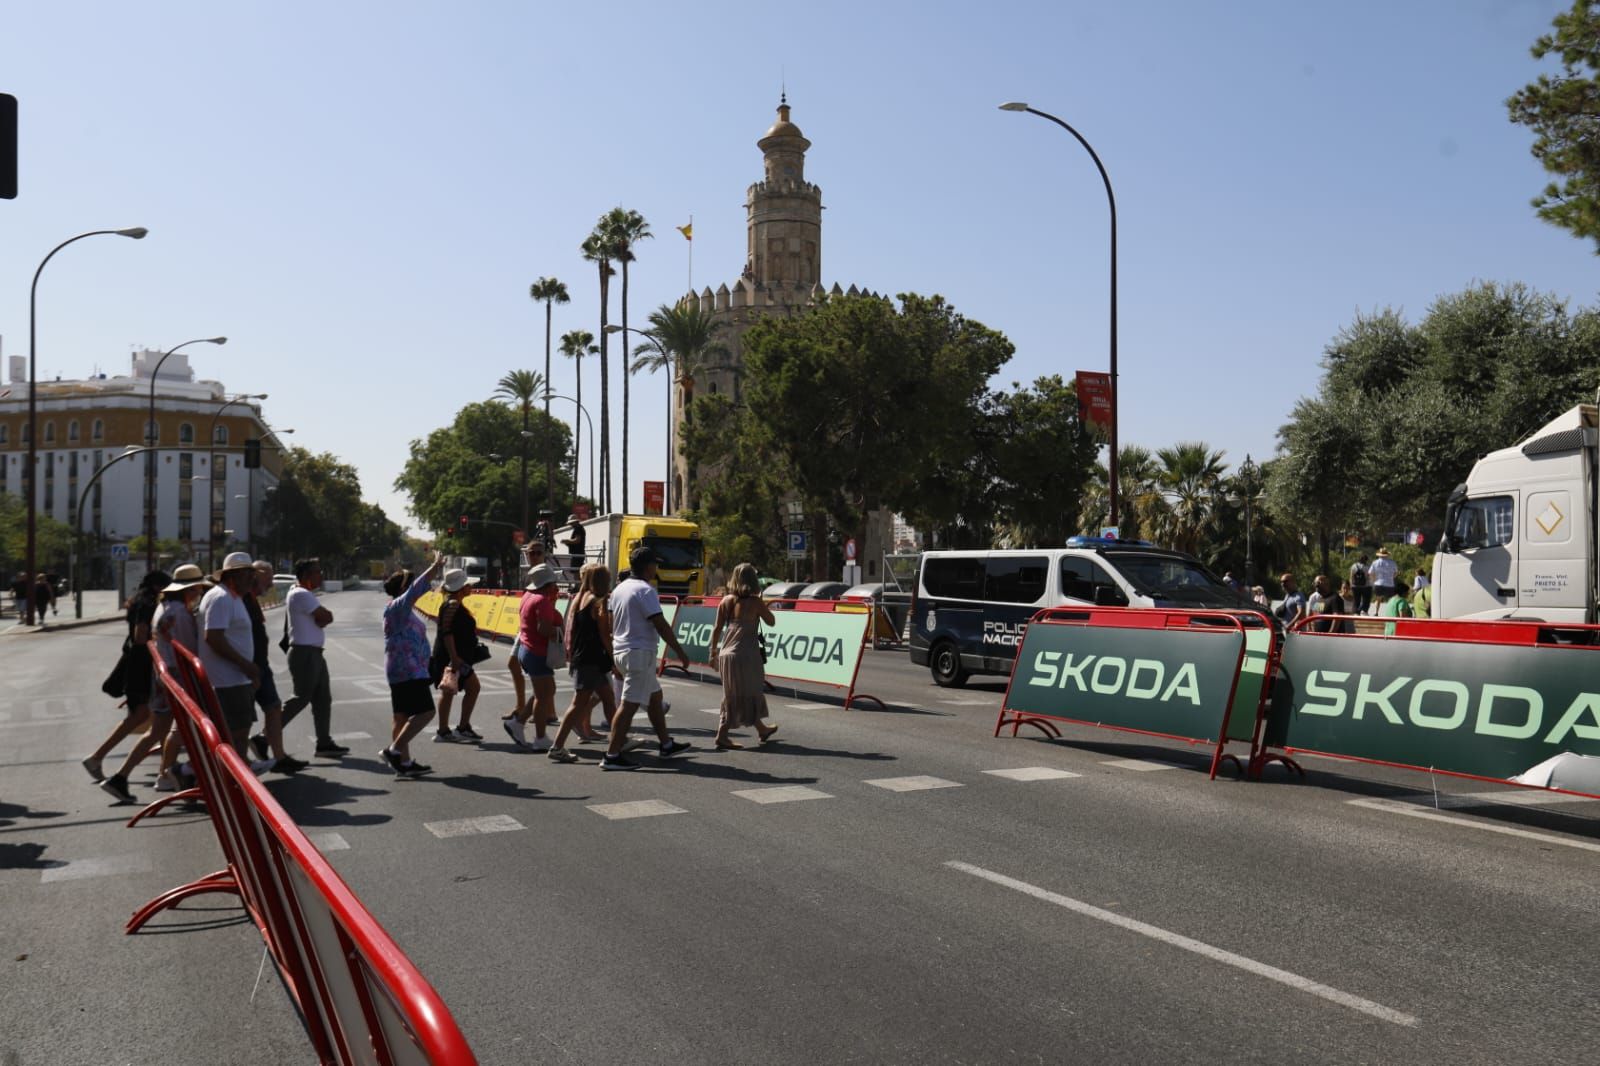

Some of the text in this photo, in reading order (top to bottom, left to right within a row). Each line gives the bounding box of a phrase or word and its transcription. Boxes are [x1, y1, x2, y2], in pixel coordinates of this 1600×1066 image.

[791, 535, 801, 548] P
[984, 621, 1027, 634] POLIC
[764, 632, 844, 666] SKODA
[983, 633, 1023, 646] NACIO
[1028, 651, 1201, 706] SKODA
[1300, 670, 1600, 744] SKODA
